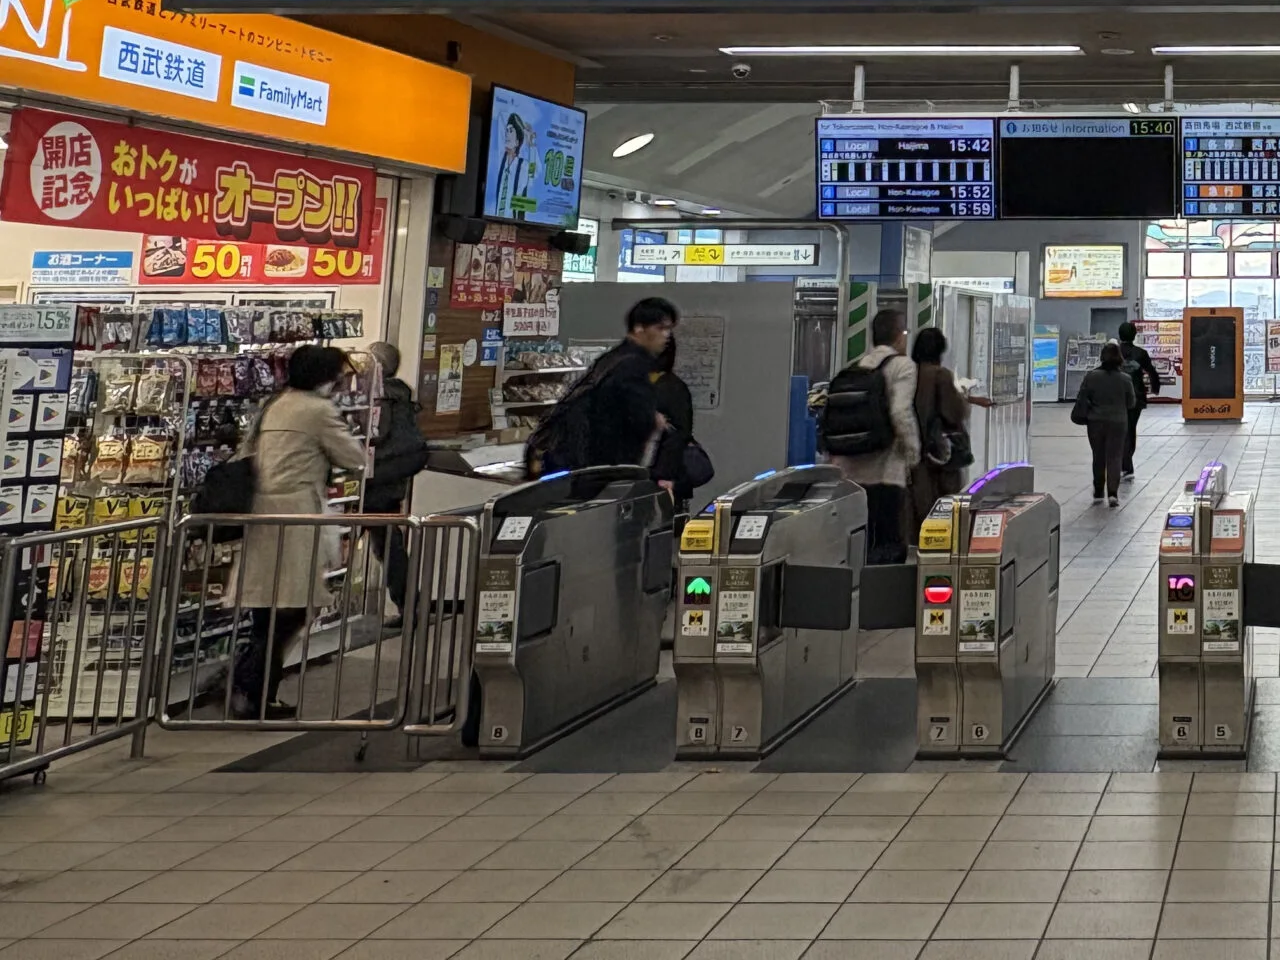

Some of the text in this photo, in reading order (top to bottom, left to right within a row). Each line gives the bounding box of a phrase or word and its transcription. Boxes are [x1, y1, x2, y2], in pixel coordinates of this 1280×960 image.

[118, 40, 206, 88] 西武鉄道
[259, 81, 323, 112] FamilyMart
[1062, 121, 1125, 133] Information
[1132, 121, 1173, 135] 15:40
[42, 134, 92, 171] 開店
[845, 141, 870, 151] Local
[949, 139, 990, 152] 15:42
[111, 140, 198, 185] おトクが
[41, 171, 94, 209] 記念
[846, 187, 870, 197] Local
[950, 186, 990, 199] 15:52
[846, 204, 870, 214] Local
[950, 203, 990, 216] 15:59
[48, 253, 118, 266] お酒コーナー
[192, 244, 241, 278] 50
